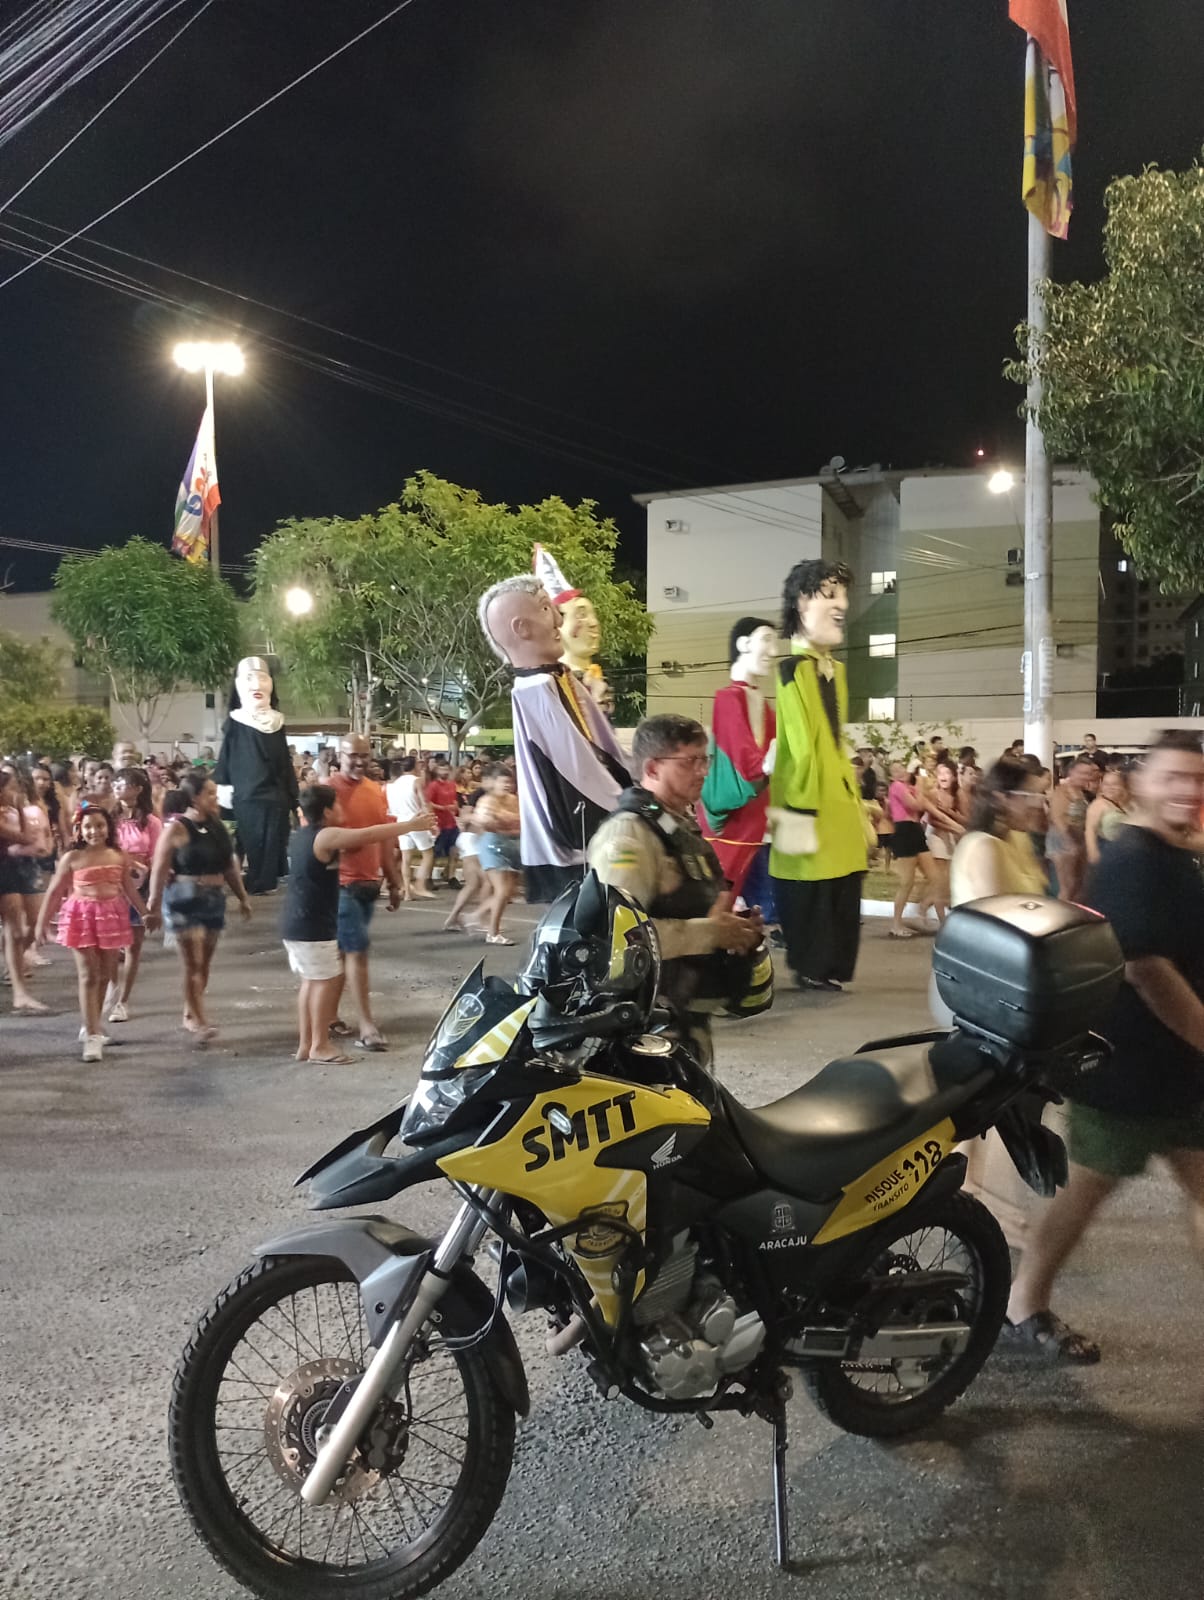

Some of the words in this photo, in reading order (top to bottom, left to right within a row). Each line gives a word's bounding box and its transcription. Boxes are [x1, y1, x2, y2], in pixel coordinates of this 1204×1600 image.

[522, 1090, 636, 1172] SMTT
[652, 1154, 682, 1170] HONDA
[864, 1170, 905, 1203] DISQUE
[759, 1235, 807, 1250] ARACAJU
